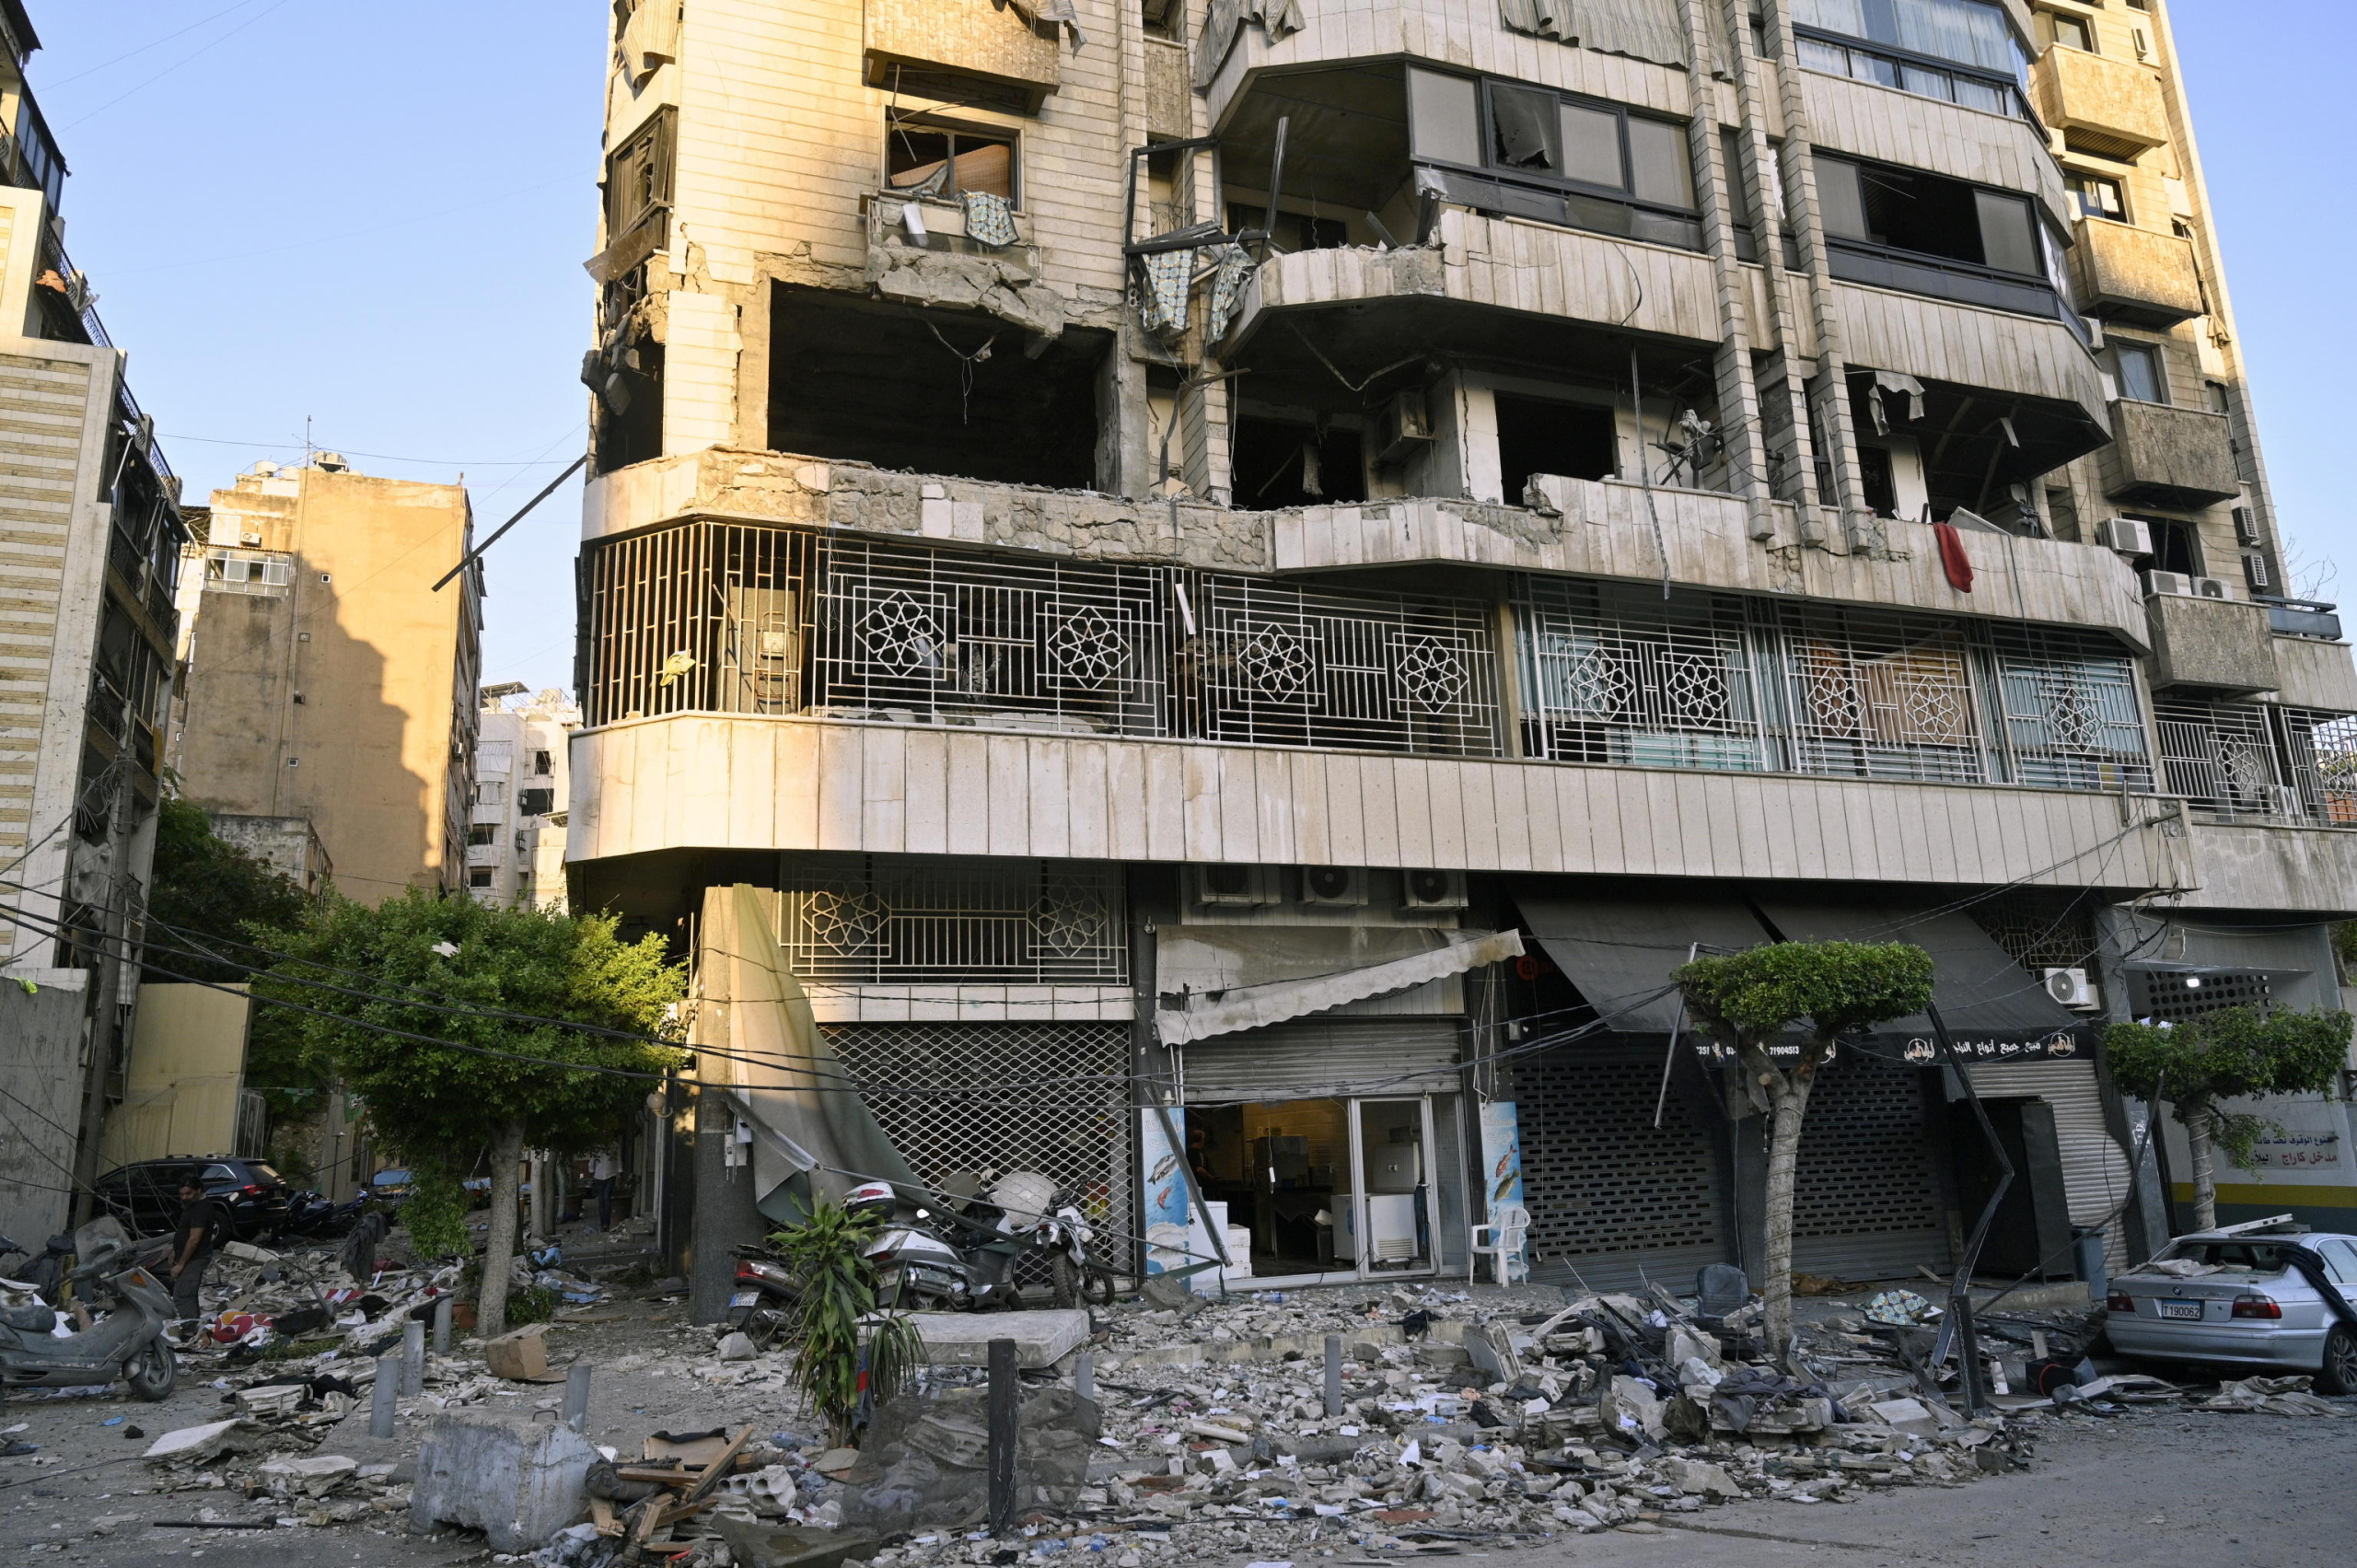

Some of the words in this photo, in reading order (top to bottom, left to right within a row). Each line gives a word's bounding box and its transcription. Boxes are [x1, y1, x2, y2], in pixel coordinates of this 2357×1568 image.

[1769, 1046, 1799, 1055] 71904513
[2000, 1041, 2020, 1055] جميع
[2289, 1134, 2312, 1146] الوقوف
[2282, 1151, 2305, 1165] كاراج
[2309, 1151, 2337, 1165] مدخل
